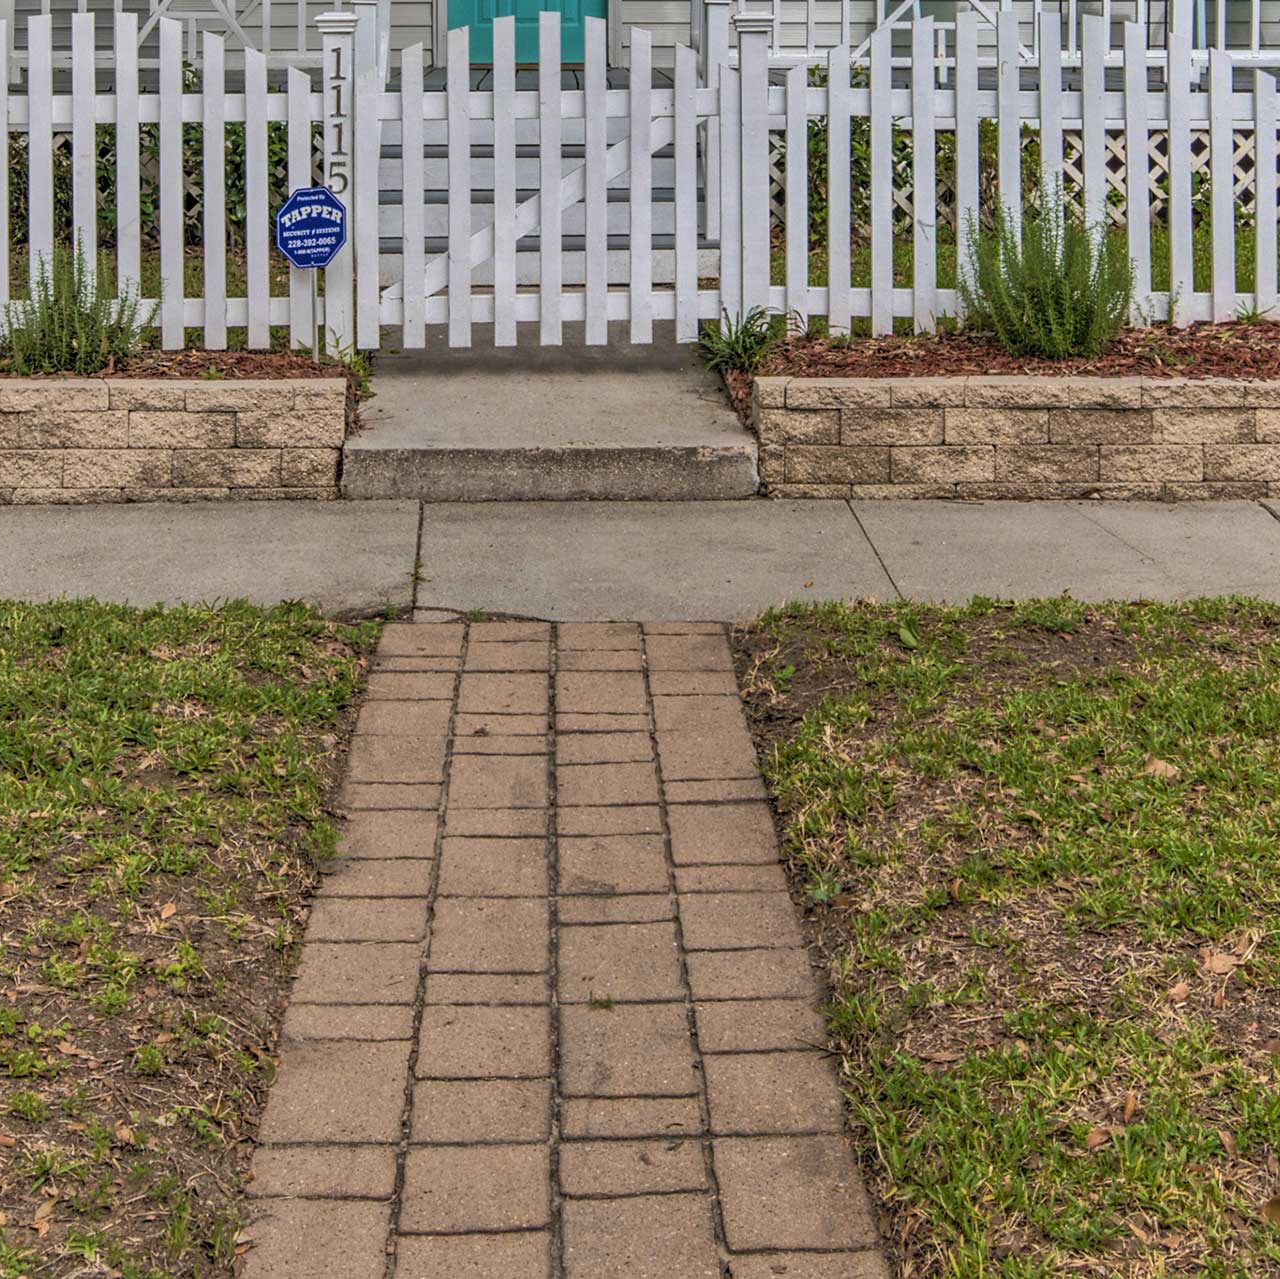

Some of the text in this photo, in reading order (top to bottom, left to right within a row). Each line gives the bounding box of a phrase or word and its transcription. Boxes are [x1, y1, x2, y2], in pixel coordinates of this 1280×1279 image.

[328, 46, 349, 194] 1115
[281, 205, 342, 227] TAPPER
[283, 229, 310, 237] SECURITY
[288, 237, 336, 248] 228-392-0065
